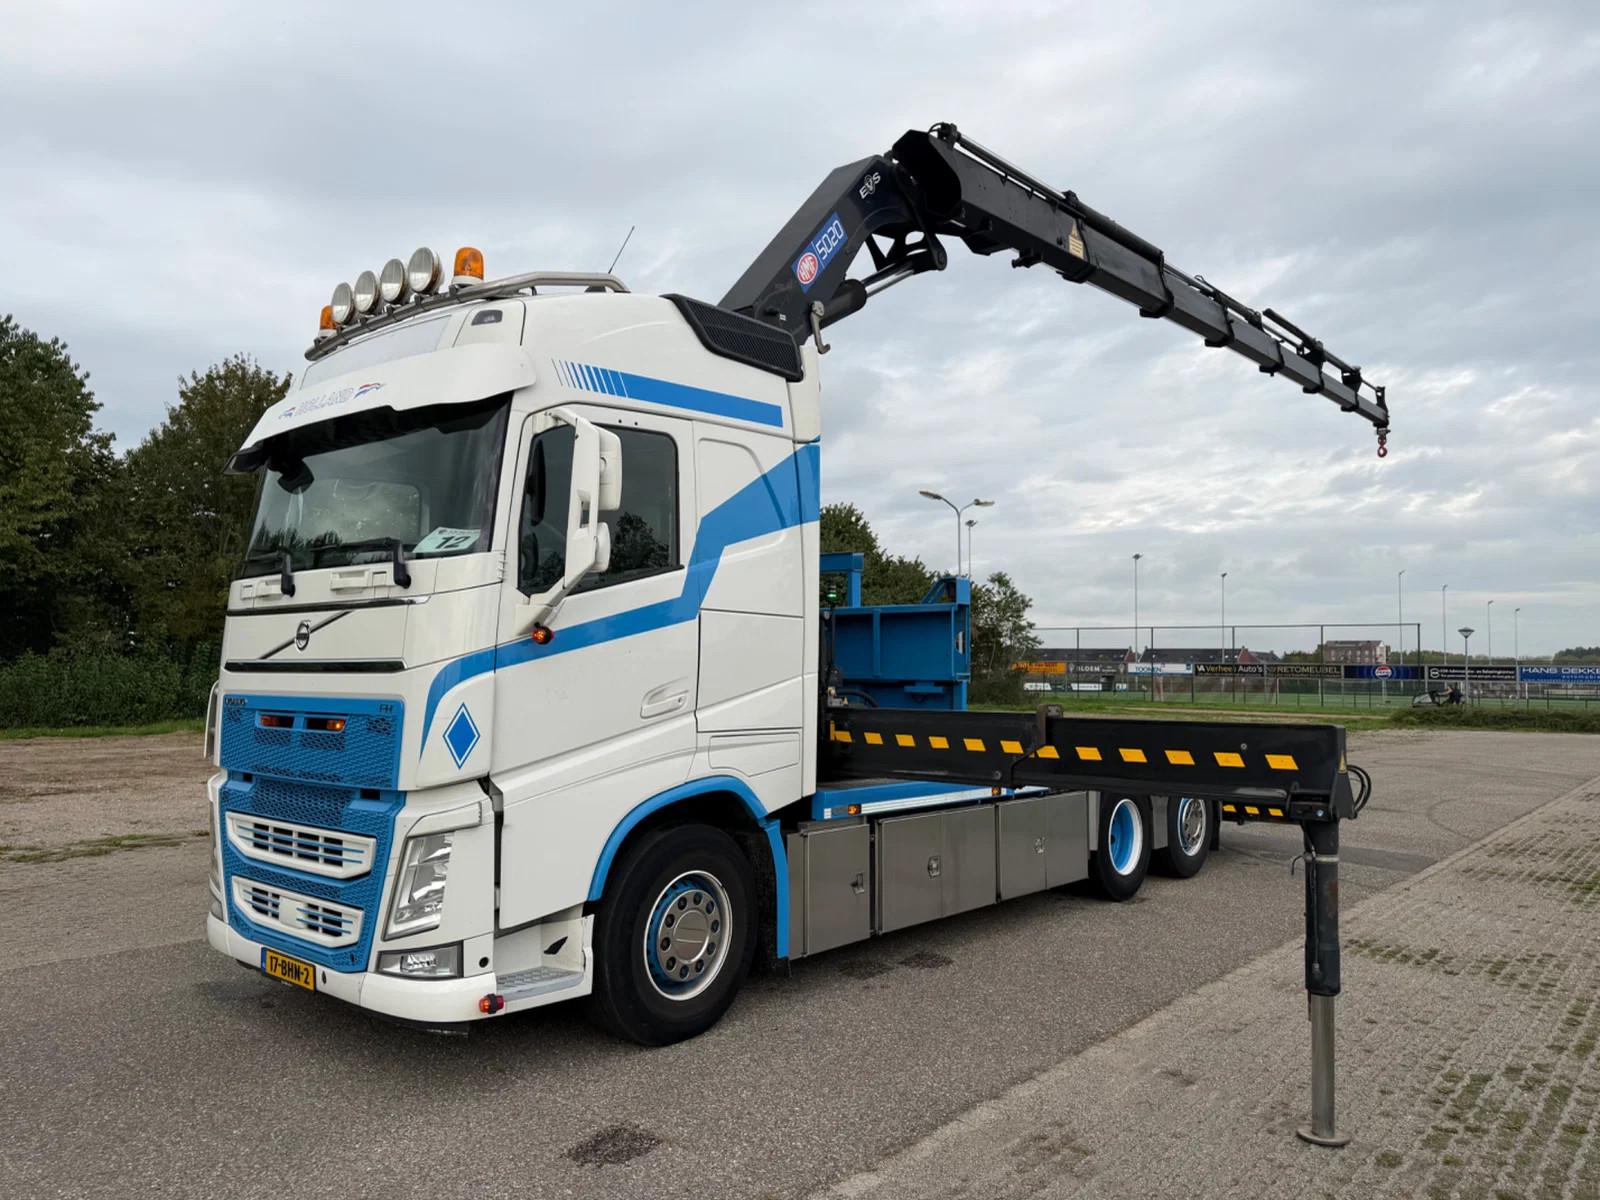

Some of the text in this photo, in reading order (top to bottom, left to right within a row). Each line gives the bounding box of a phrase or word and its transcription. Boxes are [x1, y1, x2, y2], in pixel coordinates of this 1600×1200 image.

[816, 220, 843, 260] 5020
[435, 535, 471, 549] 12
[1238, 664, 1263, 673] Auto's
[269, 955, 310, 985] 17-BHN-2
